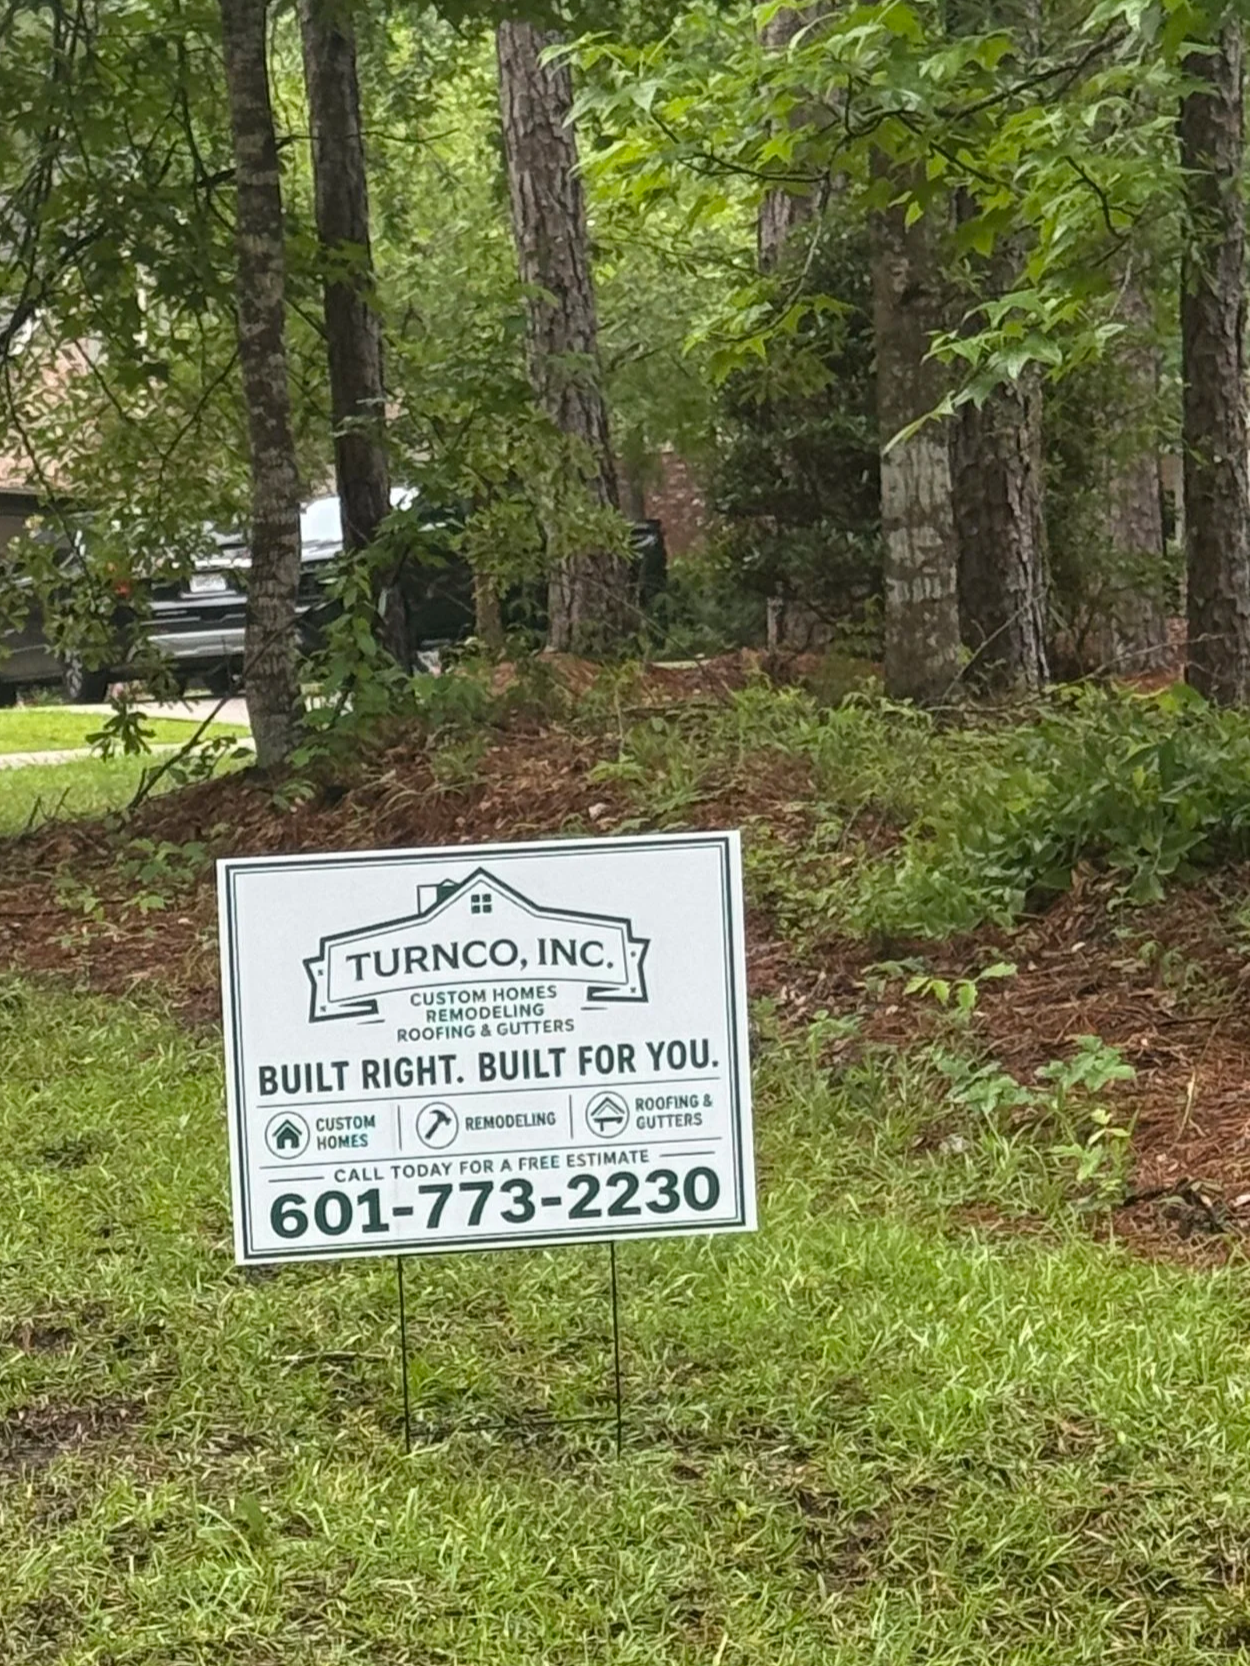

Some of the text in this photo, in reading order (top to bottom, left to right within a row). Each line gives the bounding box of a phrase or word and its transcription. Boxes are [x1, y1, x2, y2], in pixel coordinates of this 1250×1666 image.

[345, 937, 615, 982] TURNCO, INC.
[409, 985, 558, 1007] CUSTOM HOMES
[425, 1002, 546, 1024] REMODELING
[396, 1018, 576, 1043] ROOFING & GUTTERS
[257, 1038, 721, 1097] BUILT RIGHT. BUILT FOR YOU.
[634, 1093, 714, 1113] ROOFING &
[315, 1114, 377, 1132] CUSTOM
[464, 1111, 557, 1131] REMODELING
[635, 1112, 704, 1131] GUTTERS
[316, 1133, 370, 1151] HOMES
[333, 1148, 651, 1183] CALL TODAY FOR A FREE ESTIMATE
[269, 1165, 721, 1240] 601-773-2230
